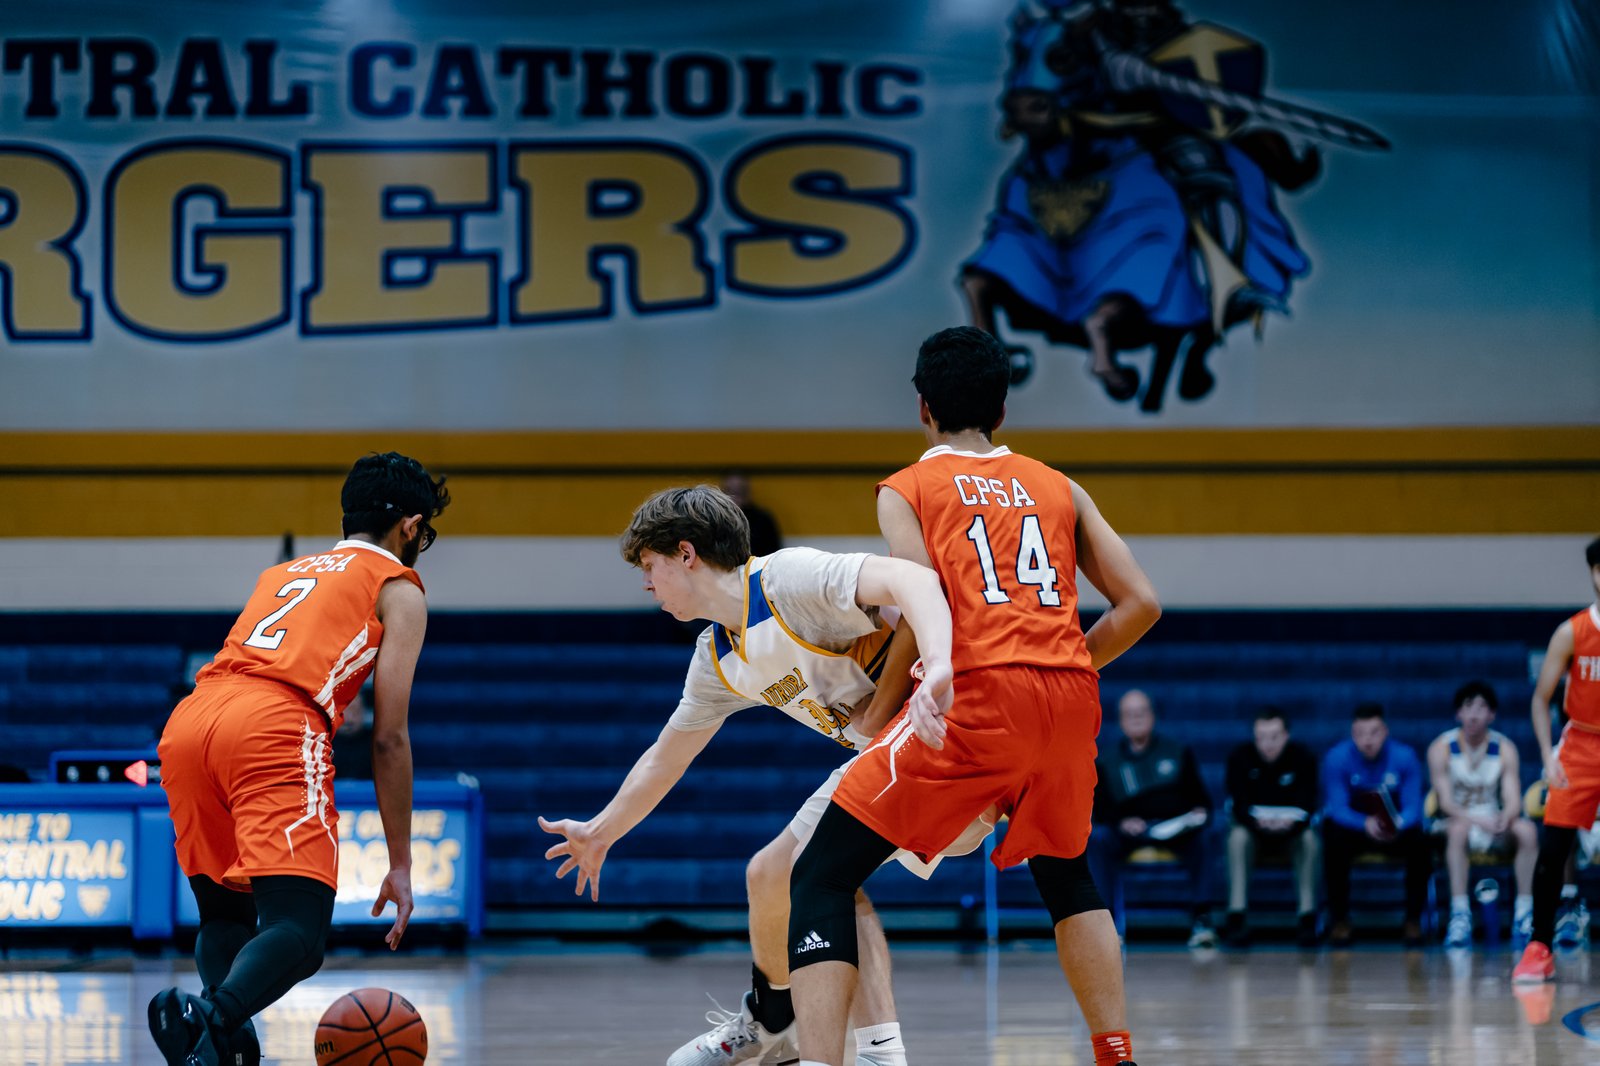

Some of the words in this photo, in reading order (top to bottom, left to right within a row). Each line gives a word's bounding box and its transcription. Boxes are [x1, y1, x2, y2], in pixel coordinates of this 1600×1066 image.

[5, 37, 310, 120] TRAL
[348, 42, 924, 120] CATHOLIC
[953, 474, 1036, 508] CPSA
[286, 552, 358, 573] CPSA
[965, 513, 1061, 607] 14
[242, 577, 317, 650] 2
[36, 812, 71, 842] TO
